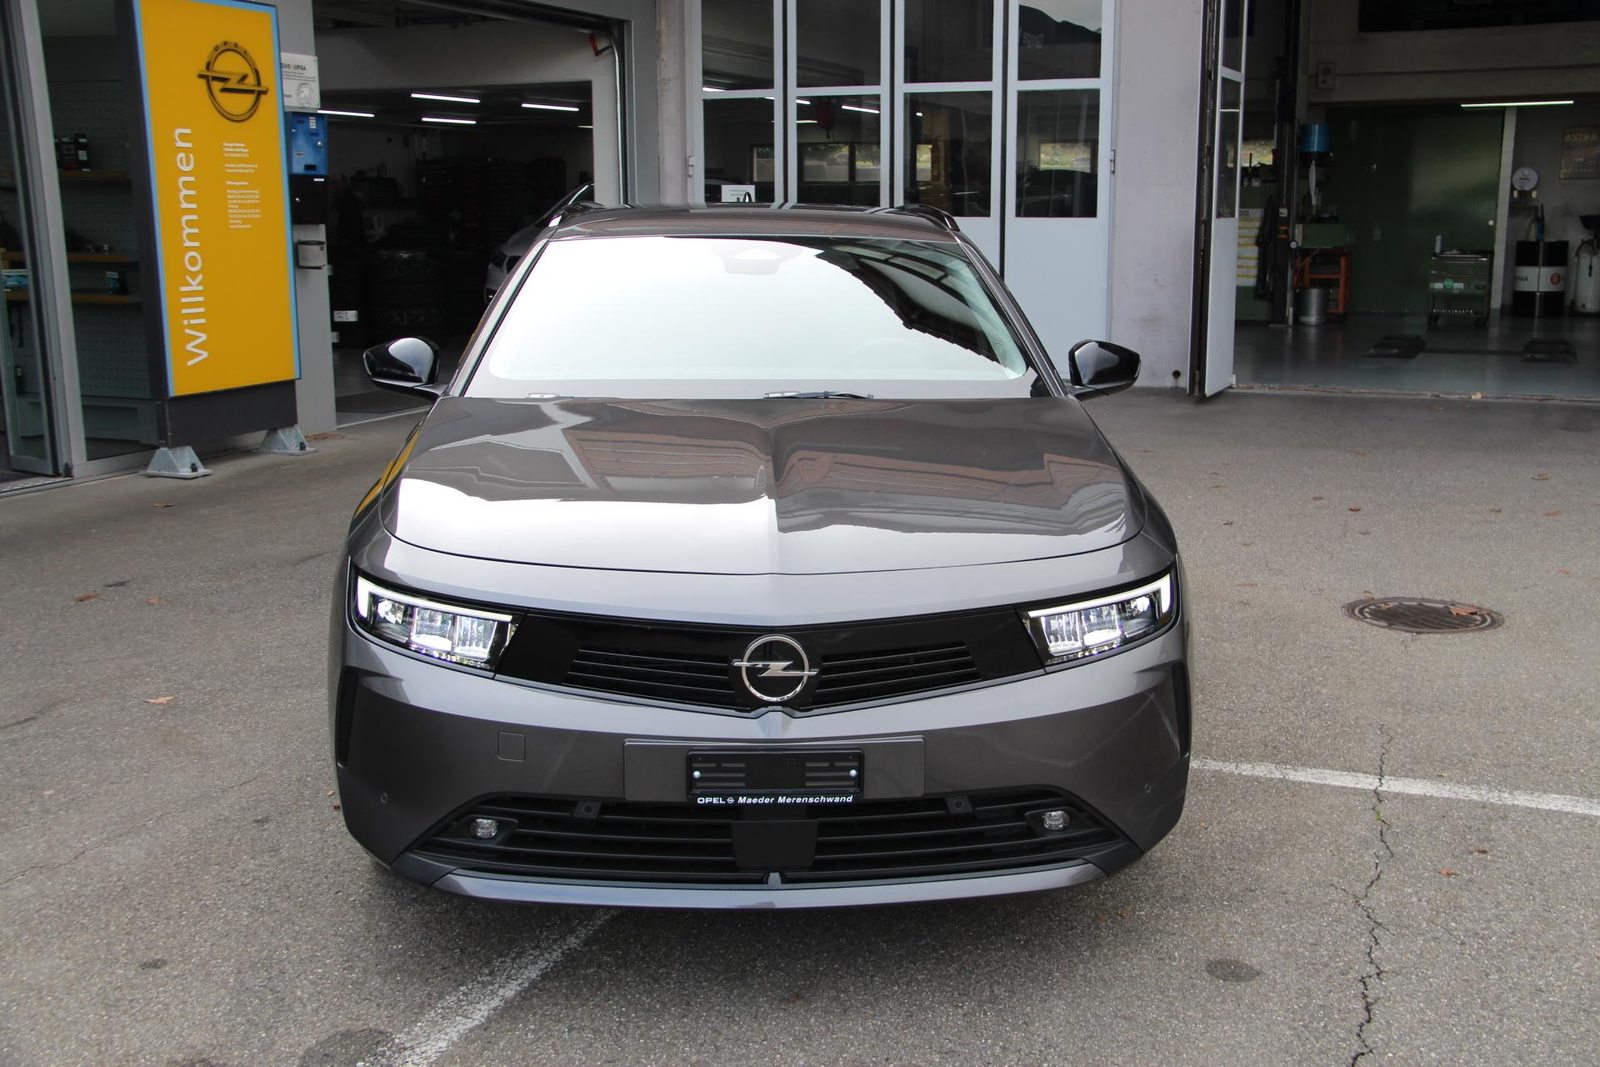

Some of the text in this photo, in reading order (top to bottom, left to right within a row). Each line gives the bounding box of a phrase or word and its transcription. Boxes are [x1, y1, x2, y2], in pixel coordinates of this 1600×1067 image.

[1564, 133, 1598, 144] ASTRA
[174, 127, 209, 367] Willkommen
[738, 796, 775, 804] Maeder
[777, 795, 853, 804] Merenschwand
